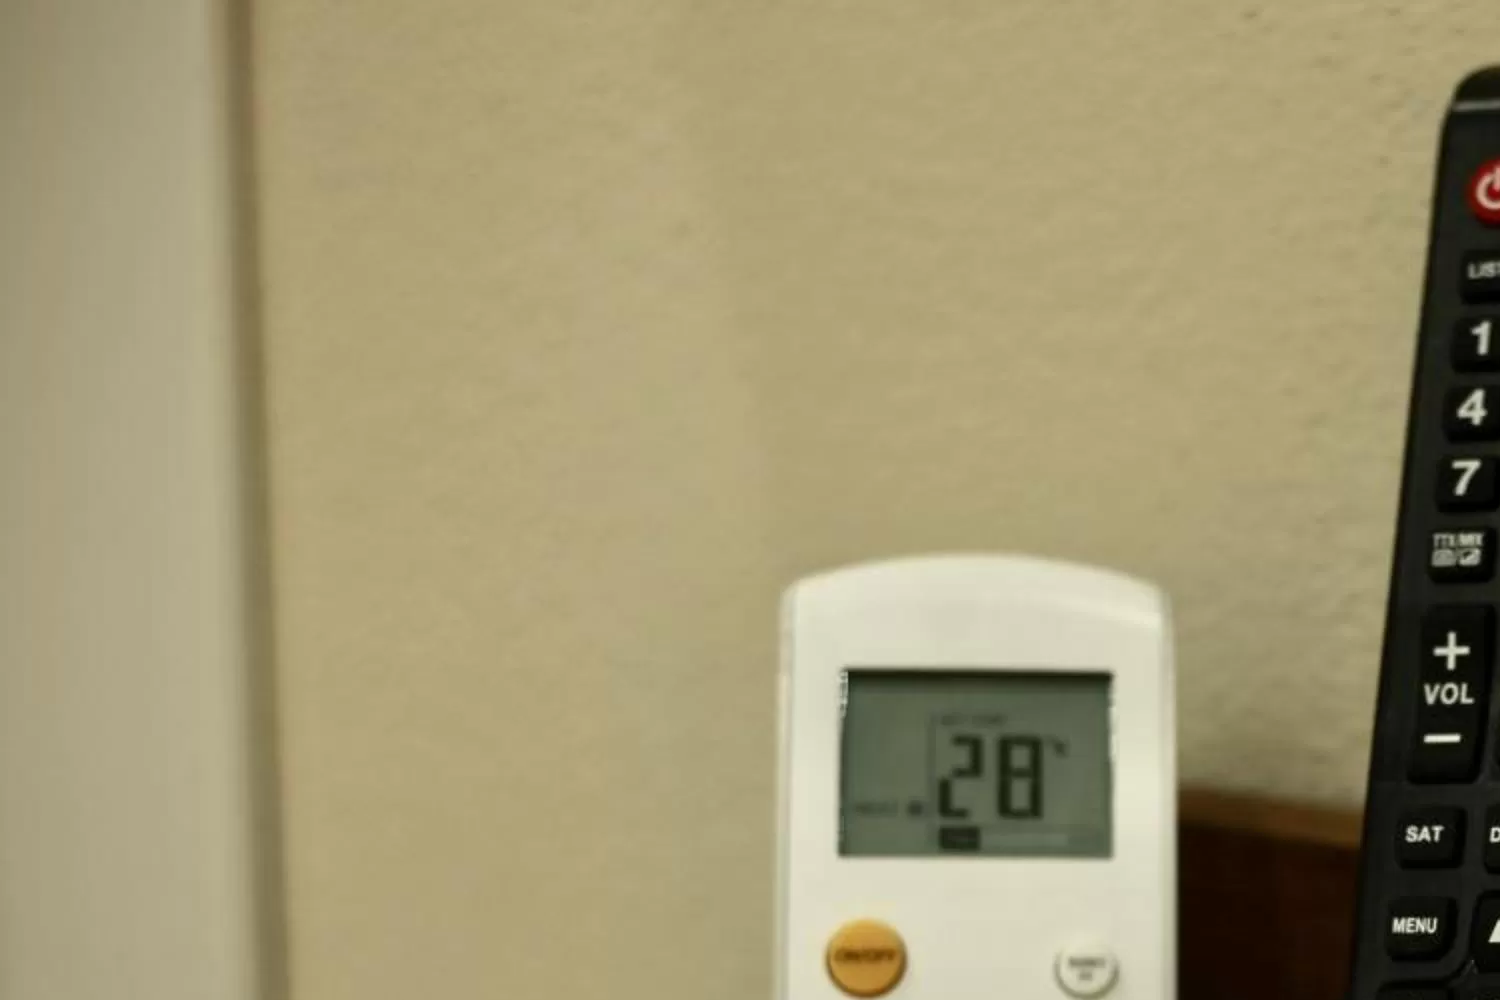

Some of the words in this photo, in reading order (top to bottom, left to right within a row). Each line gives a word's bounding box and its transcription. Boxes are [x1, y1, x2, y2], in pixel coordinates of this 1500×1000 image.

[1471, 320, 1491, 356] 1
[1456, 388, 1488, 426] 4
[1451, 459, 1482, 496] 7
[1423, 681, 1475, 705] VOL
[1405, 825, 1445, 843] SAT
[1391, 916, 1438, 934] MENU
